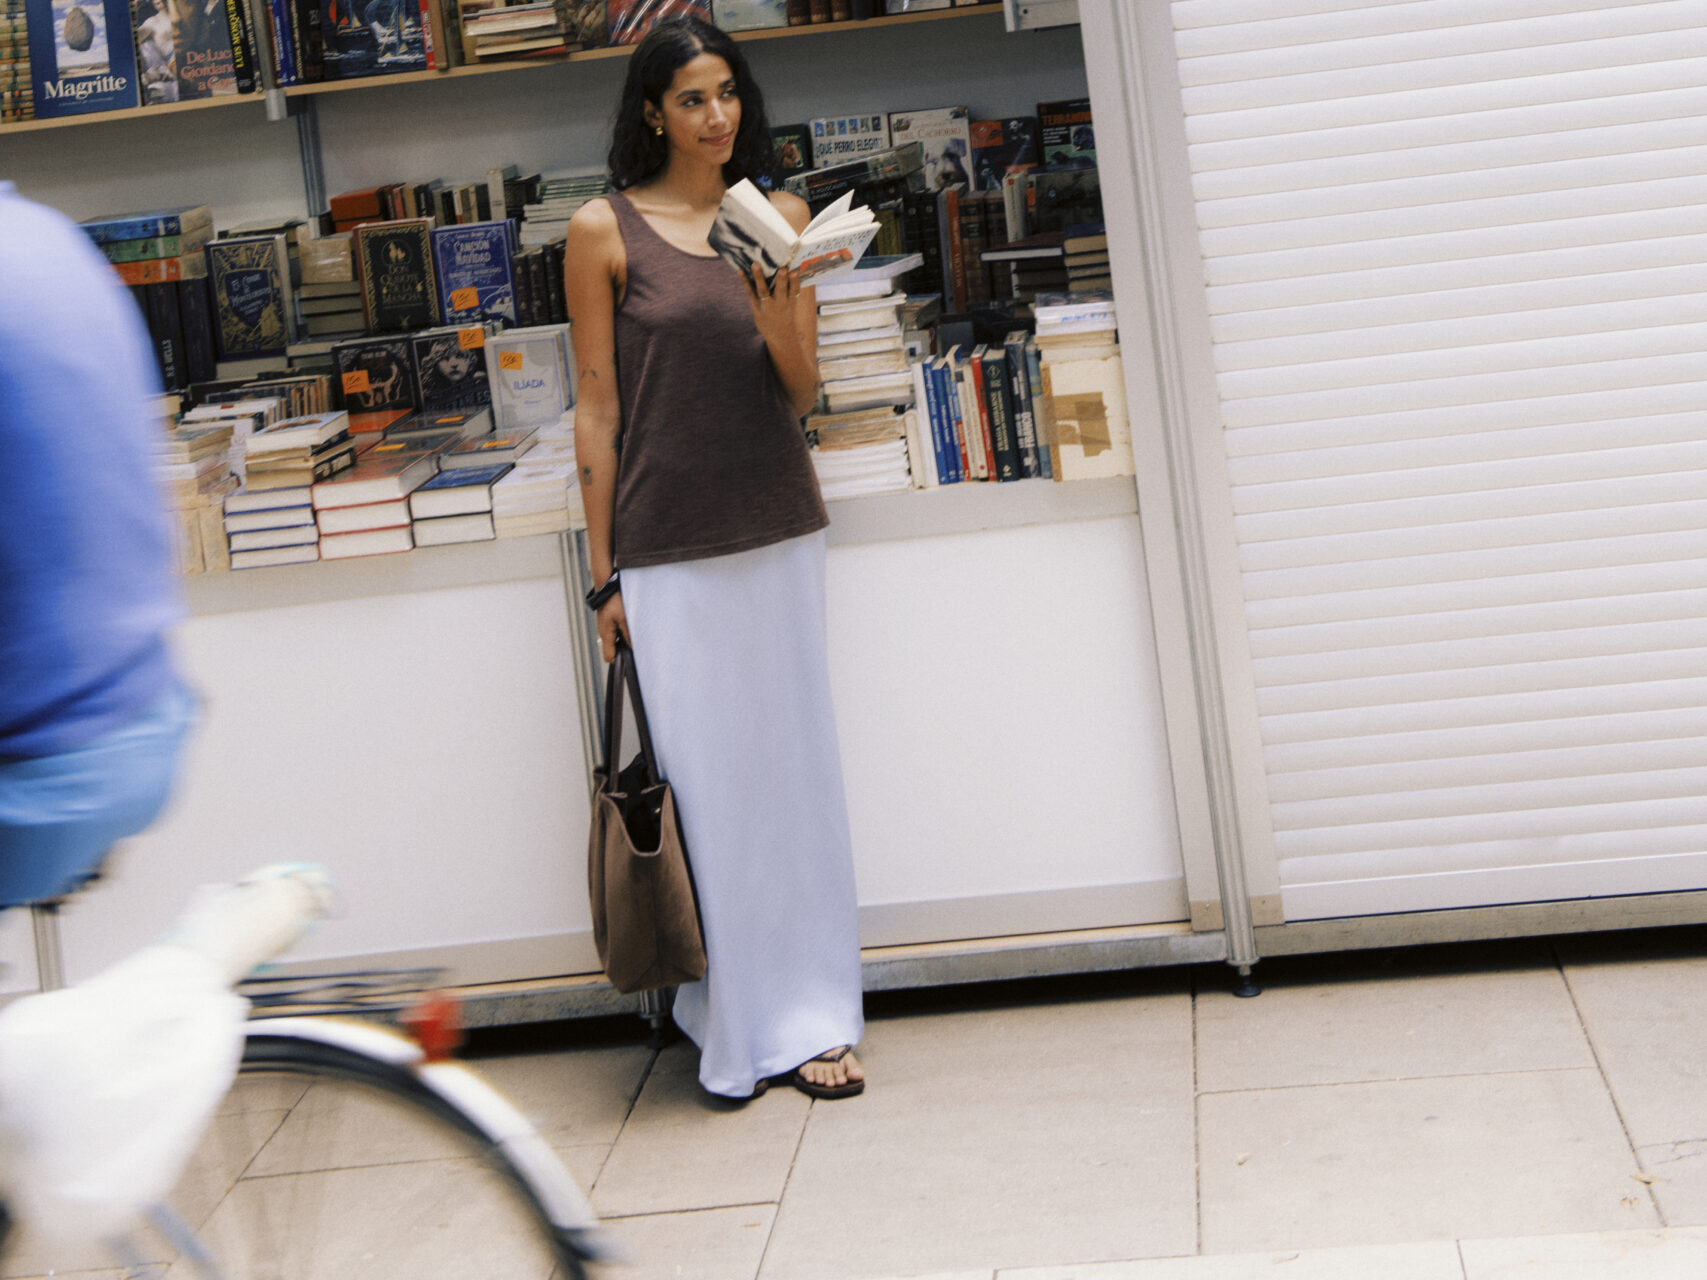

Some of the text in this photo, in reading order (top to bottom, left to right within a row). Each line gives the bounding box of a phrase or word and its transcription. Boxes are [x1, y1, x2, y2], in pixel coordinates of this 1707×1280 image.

[206, 48, 233, 62] Luc
[232, 45, 245, 69] LUIS
[180, 62, 234, 80] Giordan
[43, 76, 128, 100] Magritte
[1021, 411, 1036, 449] FRANCO
